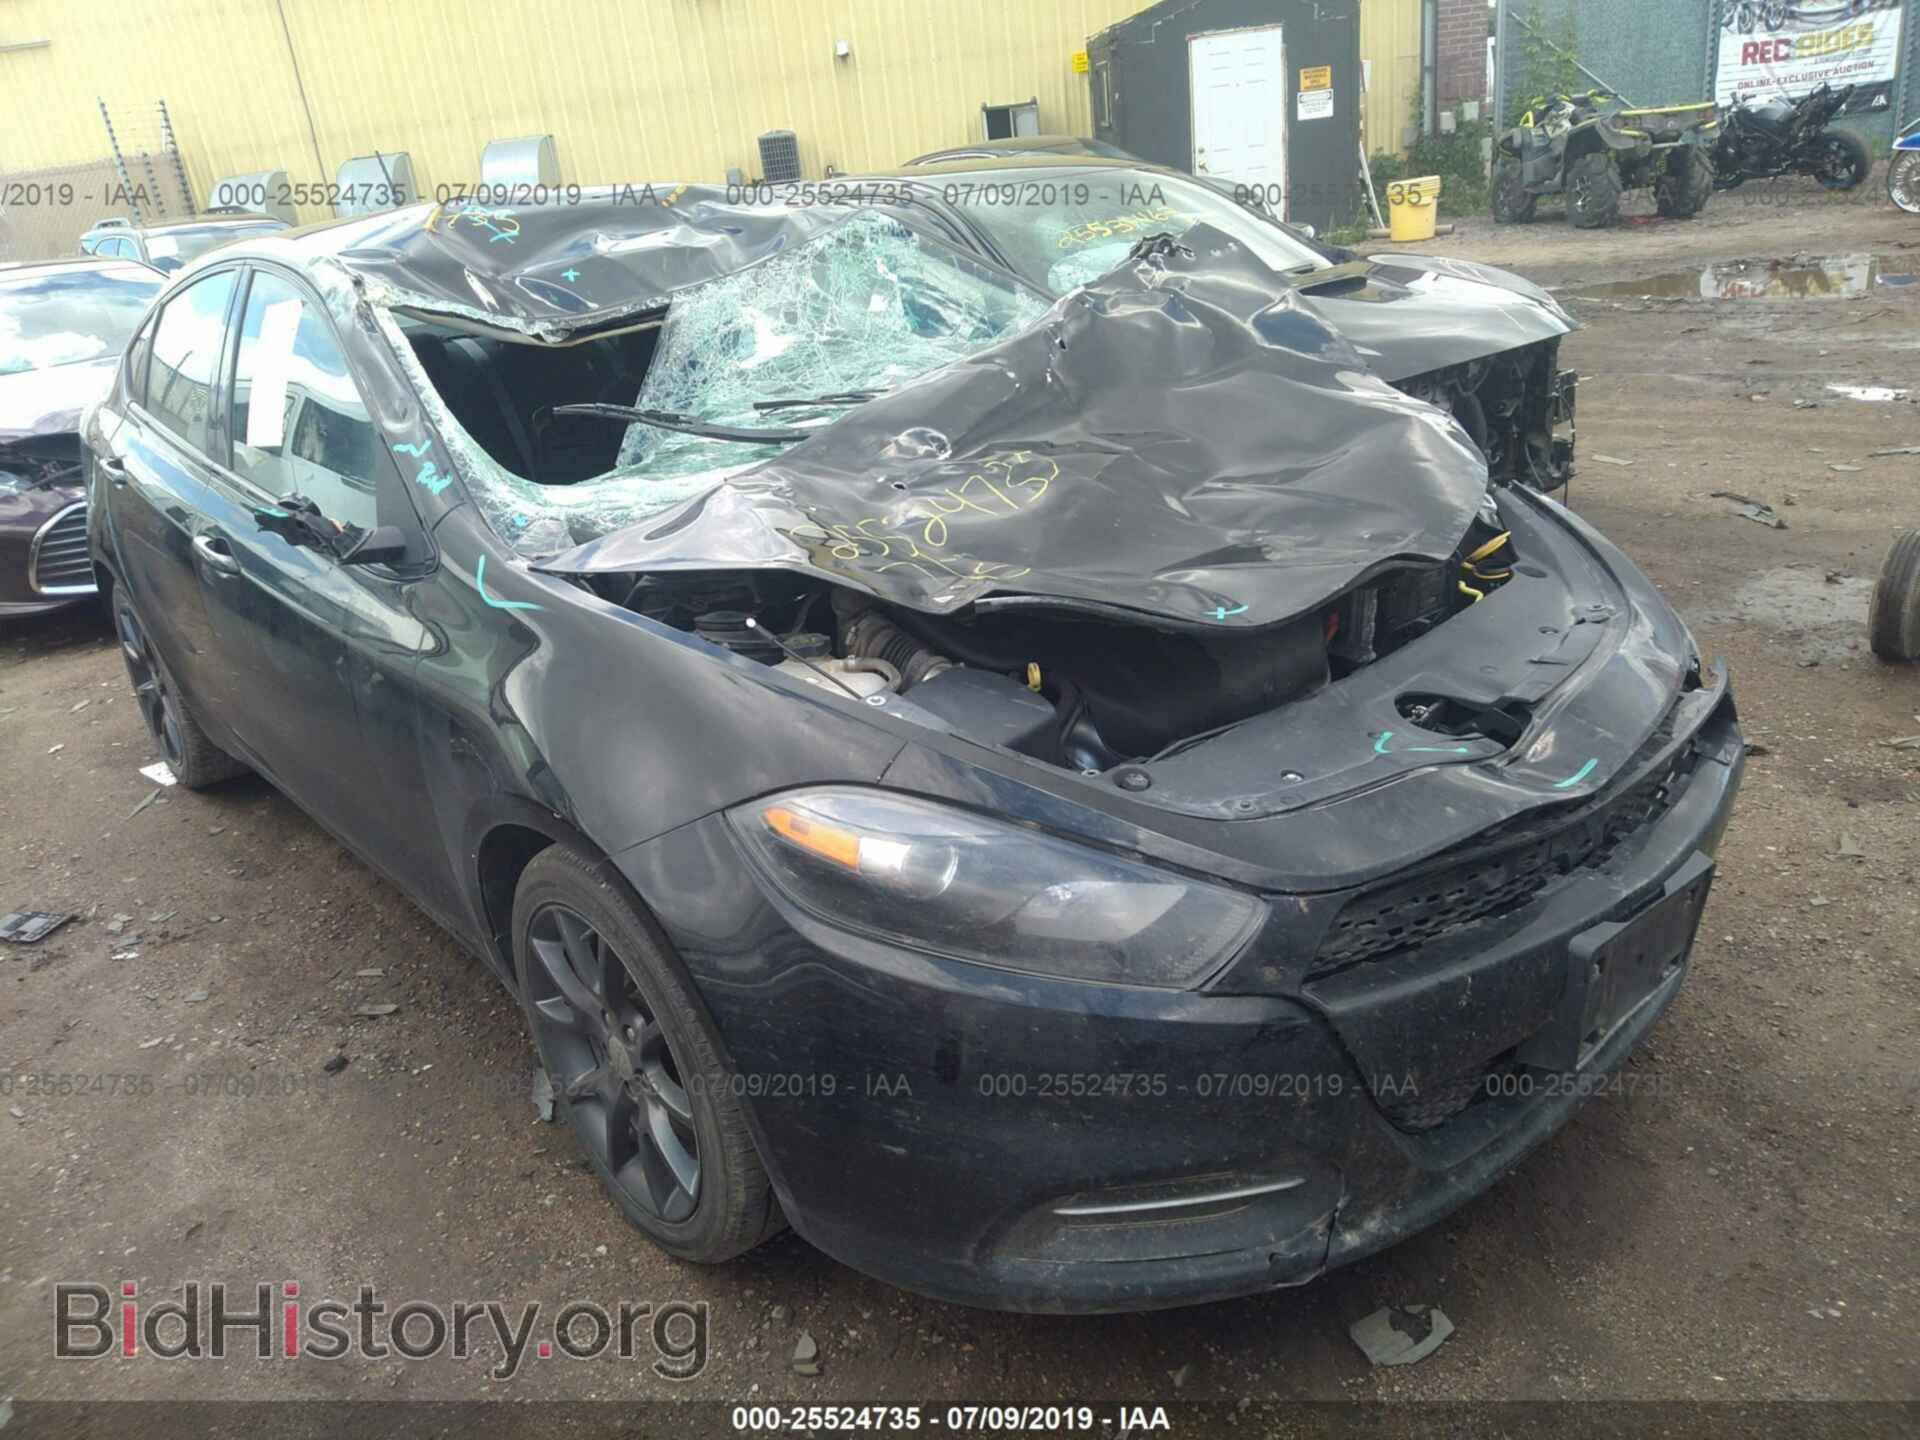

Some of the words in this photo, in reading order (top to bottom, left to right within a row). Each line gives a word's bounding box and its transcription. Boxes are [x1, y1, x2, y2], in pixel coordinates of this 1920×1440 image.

[1741, 38, 1792, 66] REC
[1737, 69, 1830, 90] ONLINE-EXCLUSIVE
[1832, 60, 1875, 77] AUCTION
